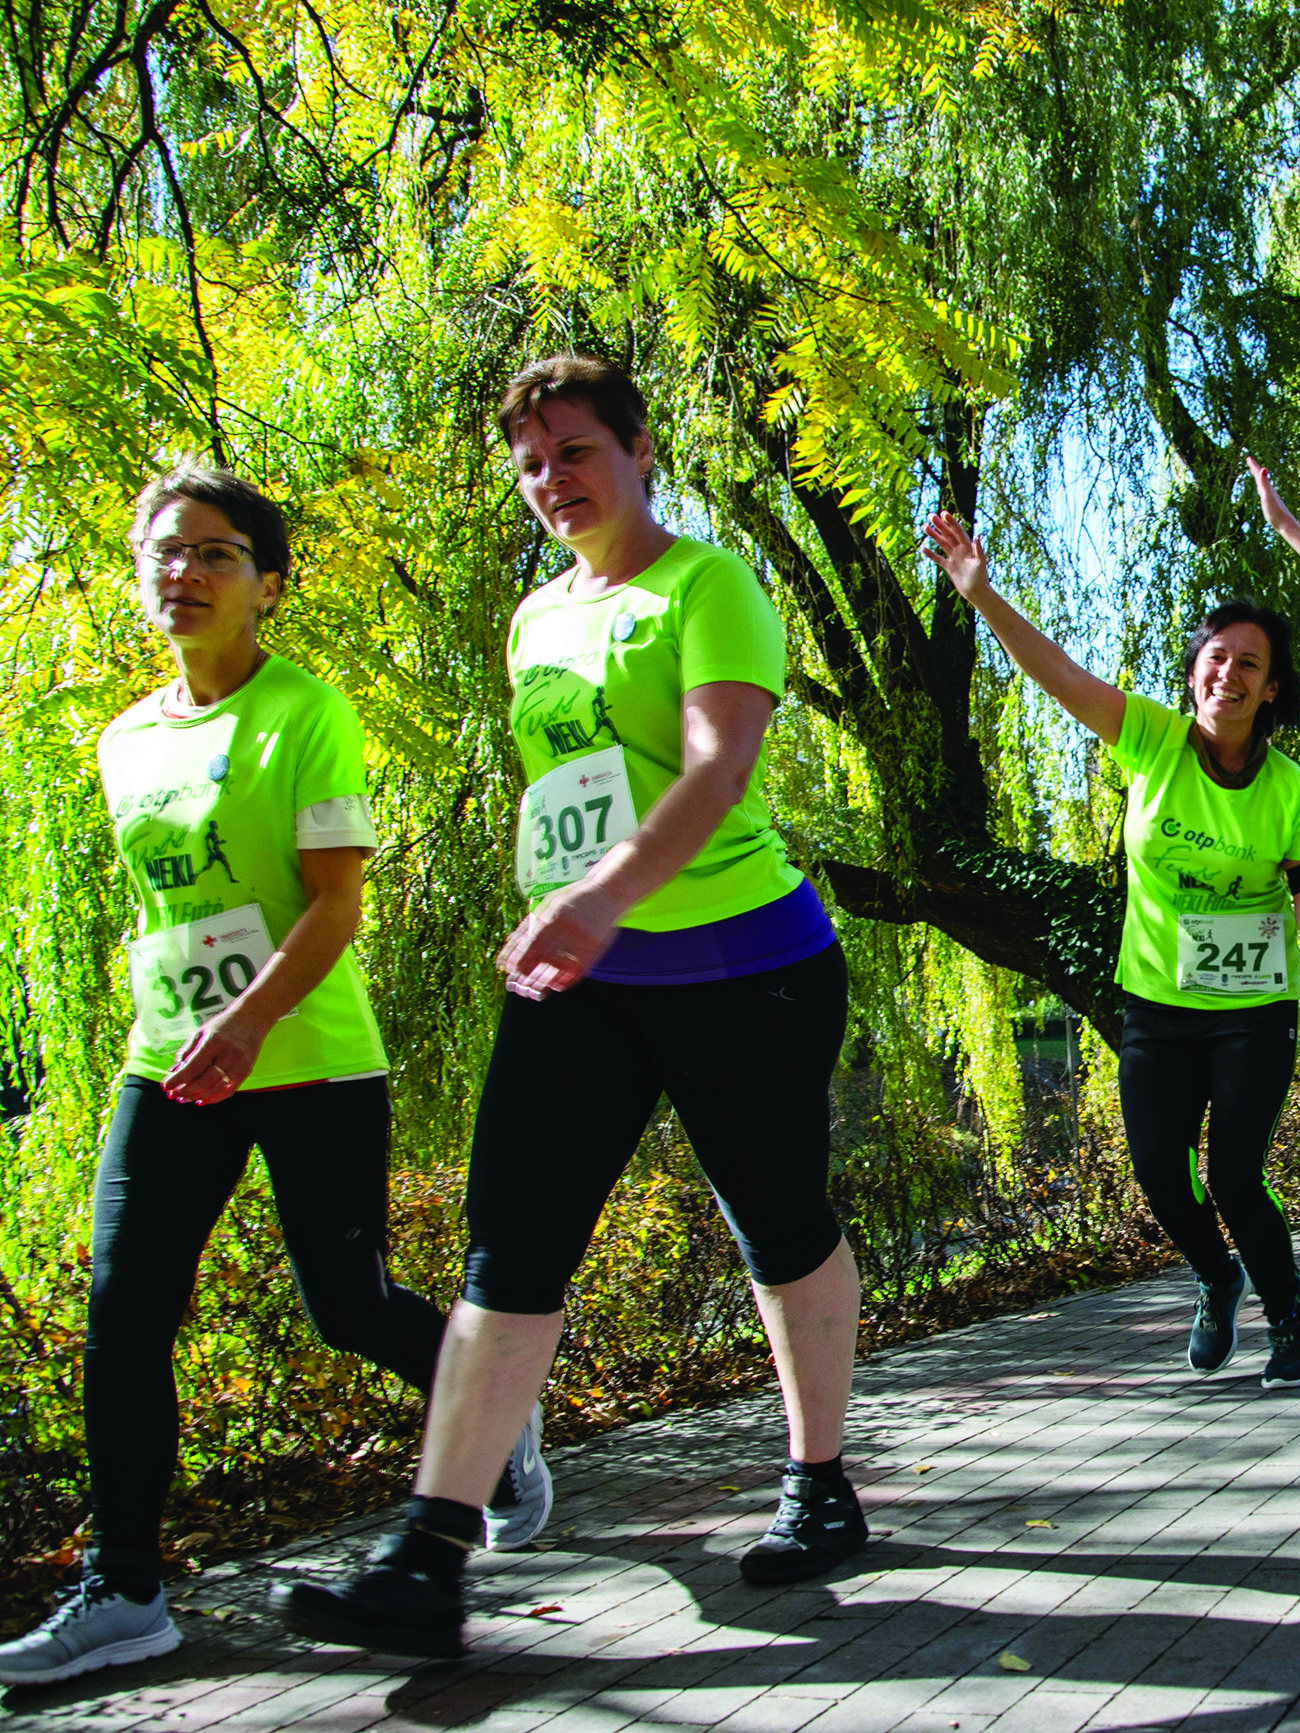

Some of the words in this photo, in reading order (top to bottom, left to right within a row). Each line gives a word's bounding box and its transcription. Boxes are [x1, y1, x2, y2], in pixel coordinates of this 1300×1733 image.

[544, 718, 595, 758] NEKI
[534, 793, 613, 861] 307
[1183, 829, 1256, 862] otpbank
[145, 851, 197, 893] NEKI
[1196, 942, 1270, 973] 247
[152, 953, 258, 1020] 320
